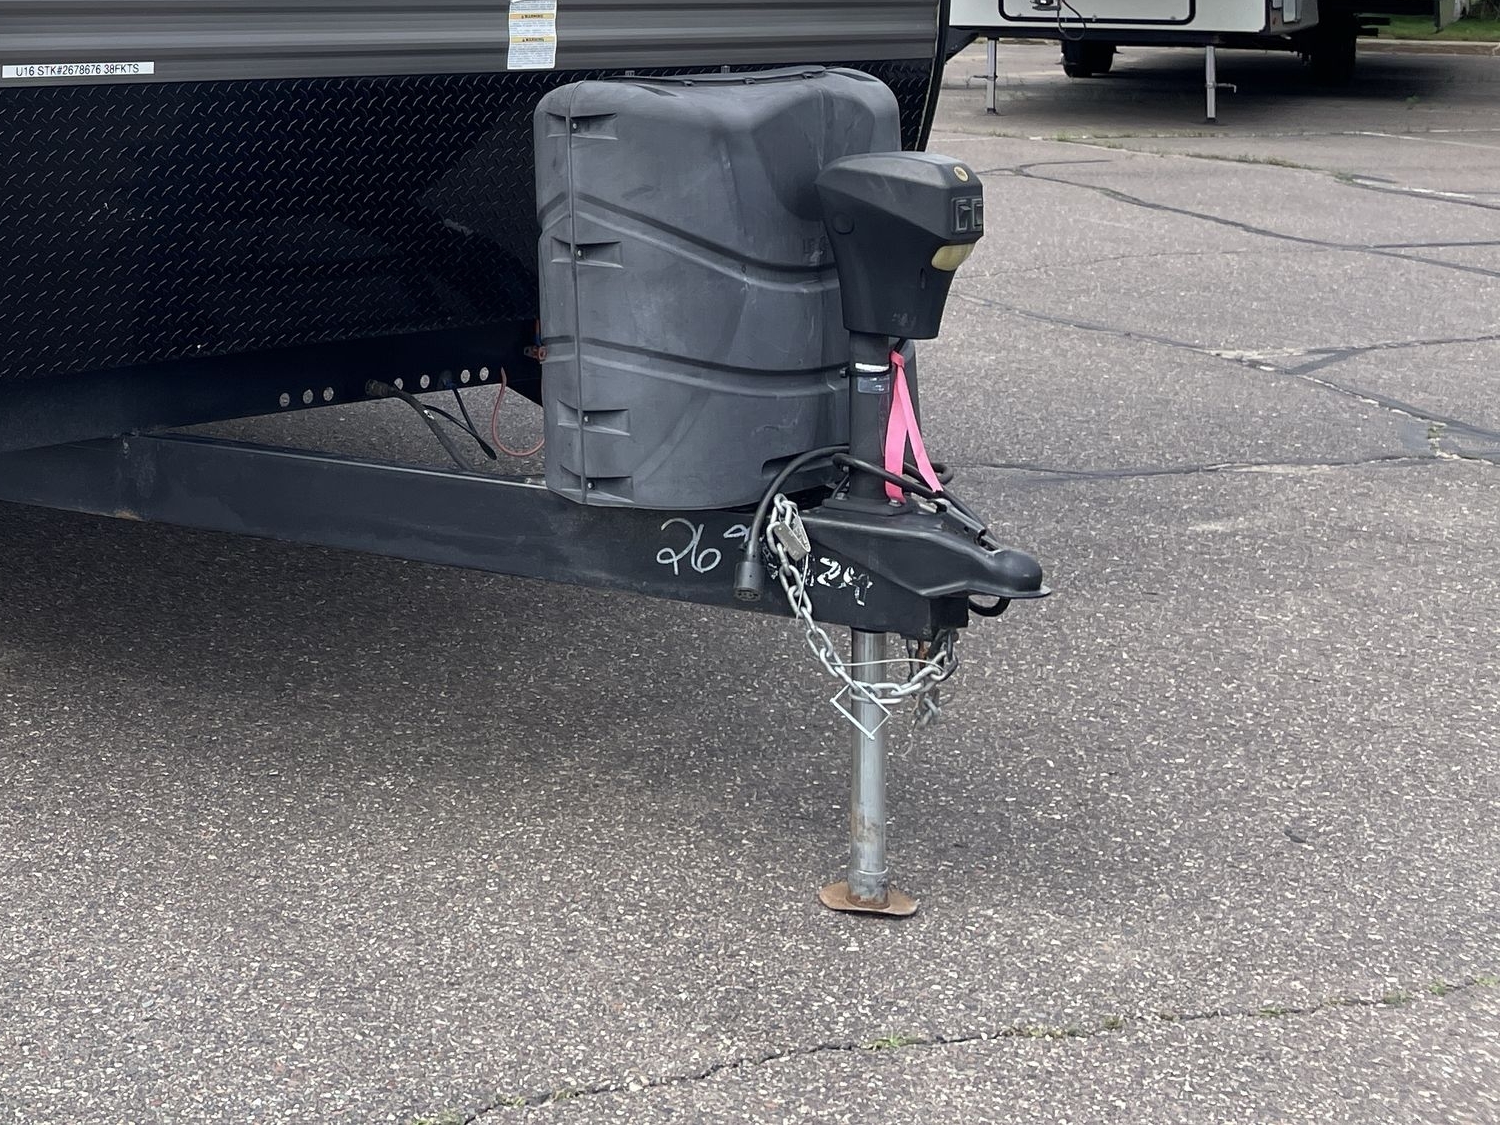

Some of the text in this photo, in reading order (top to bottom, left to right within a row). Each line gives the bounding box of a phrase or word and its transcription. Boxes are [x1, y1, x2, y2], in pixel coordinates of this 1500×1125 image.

[16, 63, 140, 77] U16 STK#2678676 38FKTS
